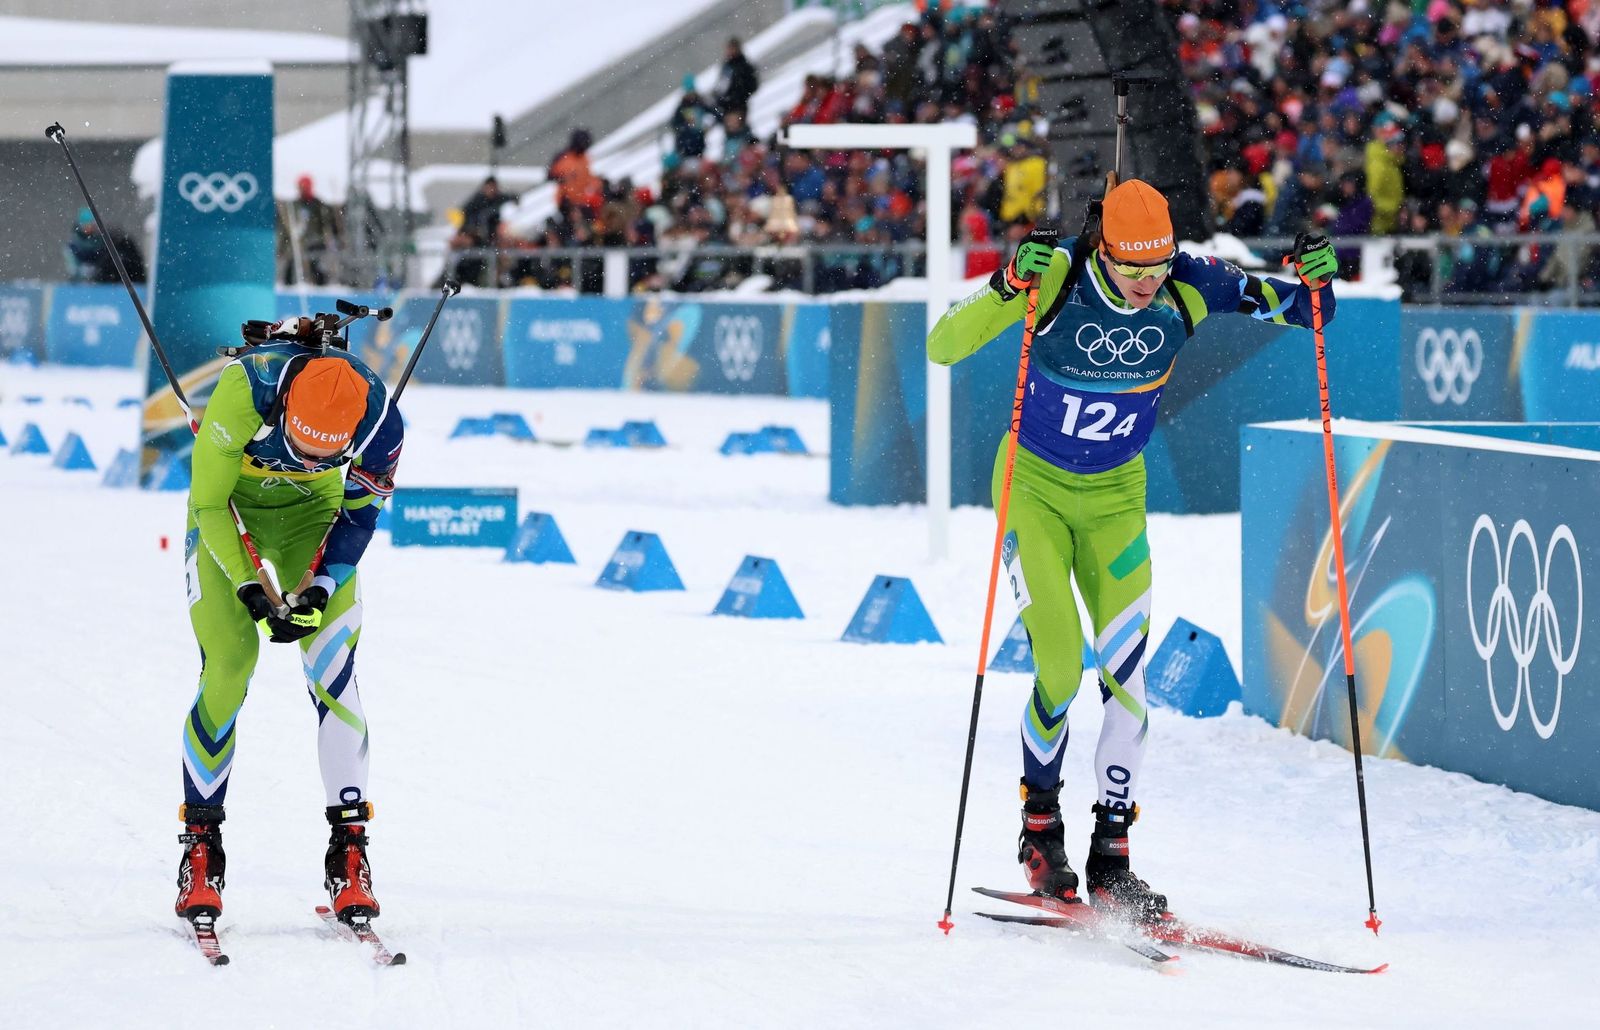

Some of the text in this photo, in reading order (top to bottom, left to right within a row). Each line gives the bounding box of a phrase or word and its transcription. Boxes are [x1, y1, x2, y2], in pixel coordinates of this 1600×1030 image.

[1061, 365, 1101, 379] MILANO
[1103, 371, 1143, 379] CORTINA
[291, 415, 349, 443] SLOVENIA
[403, 506, 506, 522] HAND-OVER
[428, 521, 480, 536] START
